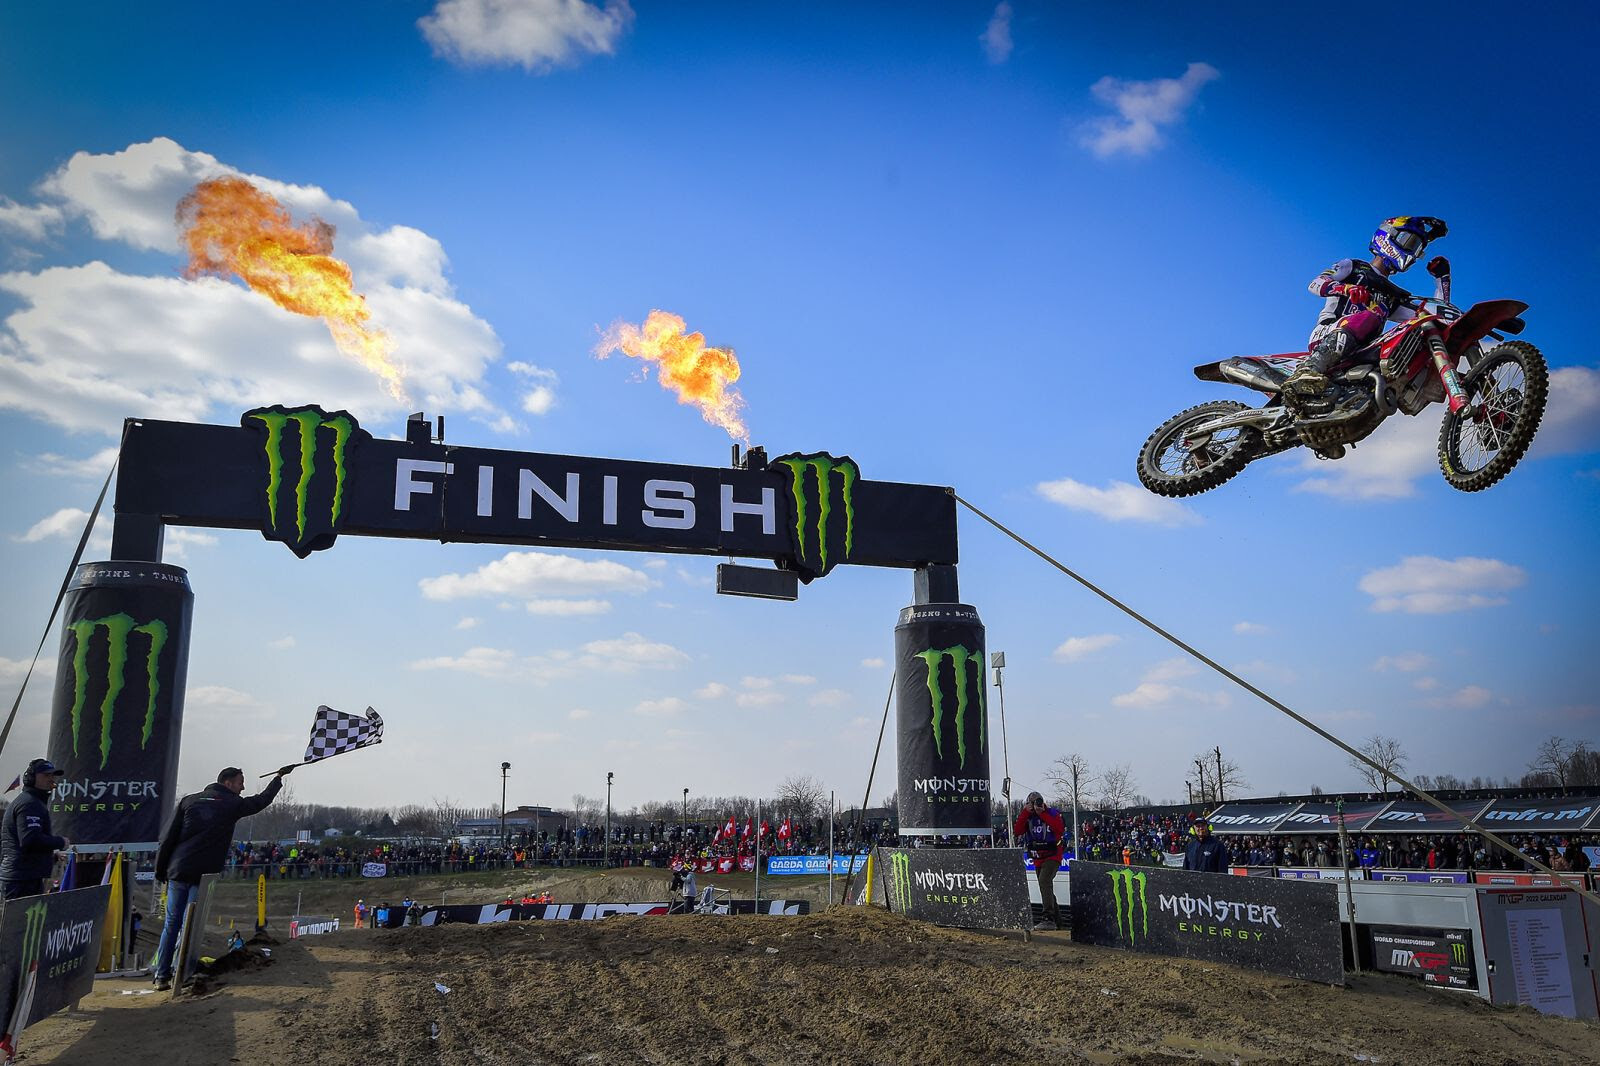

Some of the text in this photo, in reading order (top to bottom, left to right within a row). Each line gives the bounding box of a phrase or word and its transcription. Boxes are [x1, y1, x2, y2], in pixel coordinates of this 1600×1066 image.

[394, 458, 776, 535] FINISH
[914, 776, 990, 794] MONSTER
[53, 802, 141, 812] ENERGY
[1485, 806, 1592, 821] infront
[770, 861, 803, 869] GARDA
[915, 868, 989, 891] MONSTER
[926, 894, 980, 904] ENERGY
[1158, 892, 1282, 929] MONSTER
[45, 920, 94, 960] MONSTER
[1179, 922, 1263, 942] ENERGY
[1394, 938, 1436, 947] CHAMPIONSHIP
[49, 956, 87, 978] ENERGY
[1391, 949, 1449, 969] MXGP
